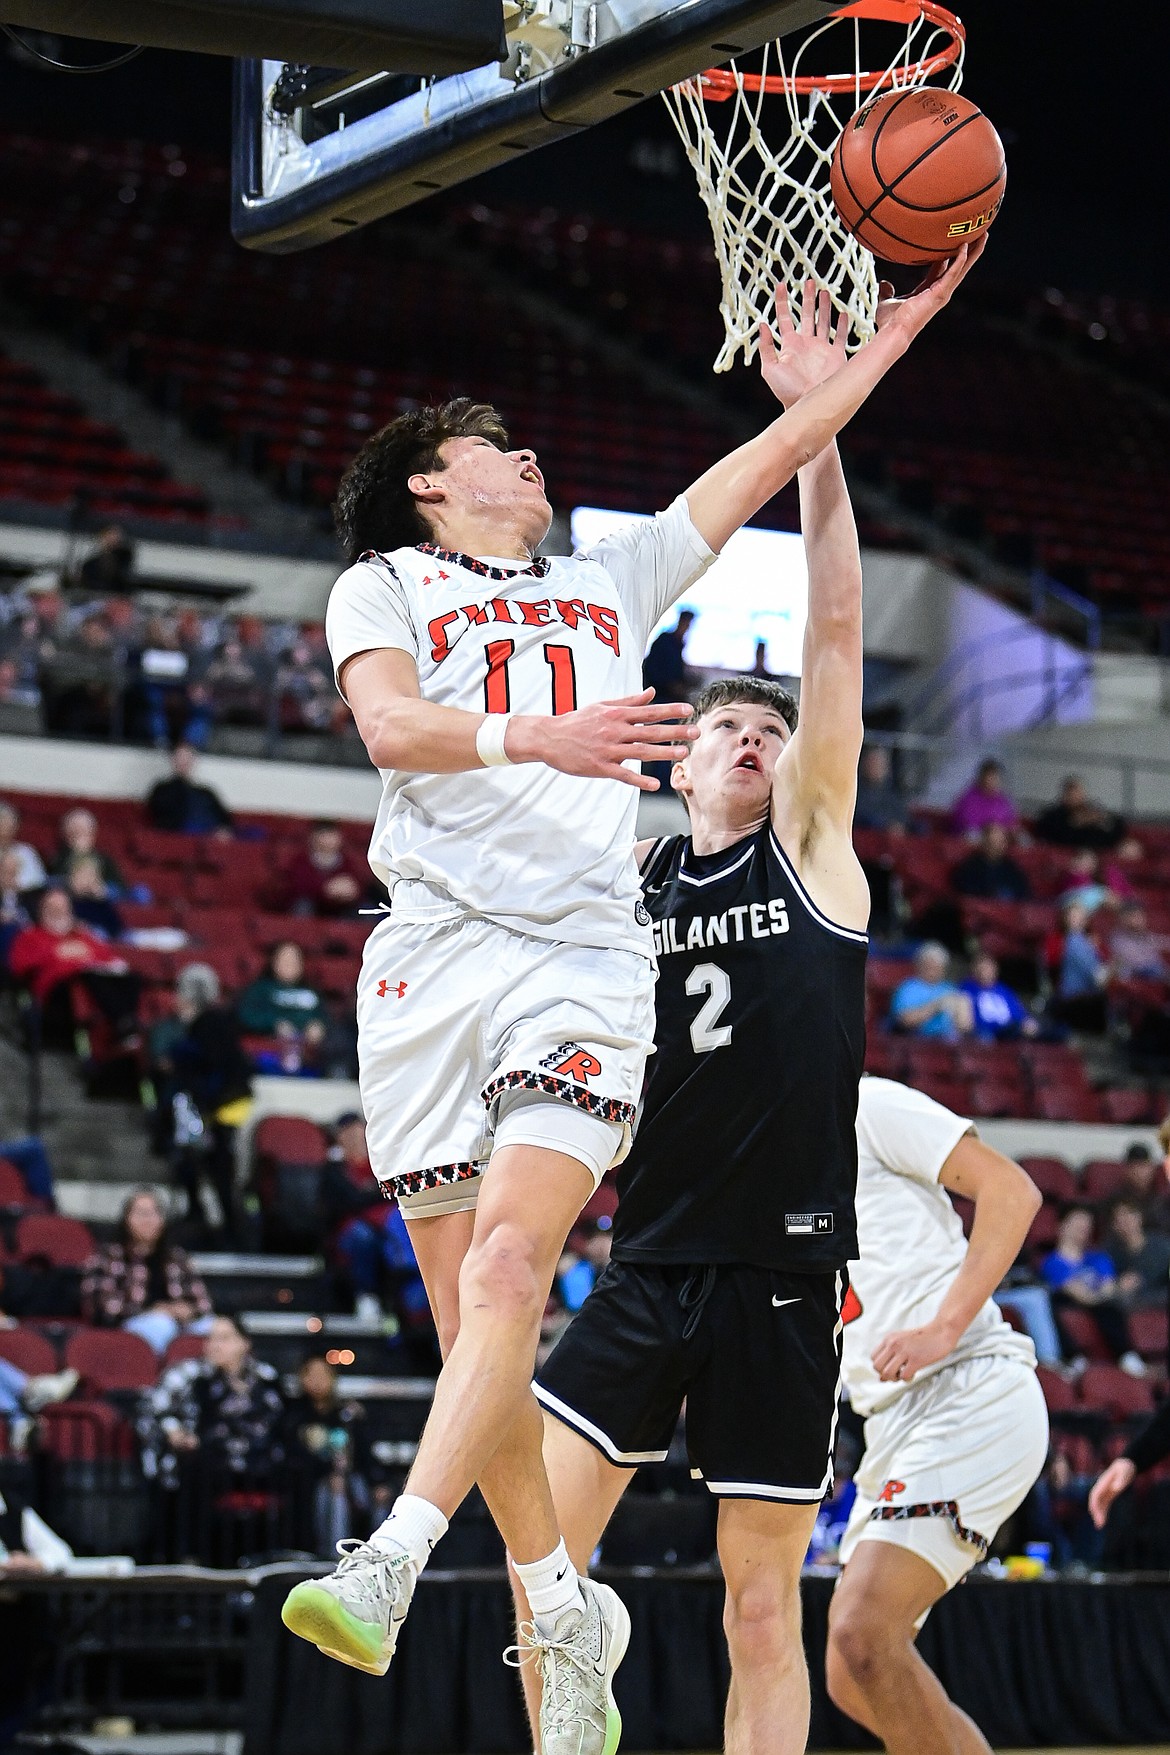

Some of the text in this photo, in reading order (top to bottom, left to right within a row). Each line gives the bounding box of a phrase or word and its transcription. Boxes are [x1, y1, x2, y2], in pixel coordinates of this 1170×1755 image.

[428, 598, 621, 663] CHIEFS
[484, 639, 578, 716] 11
[653, 898, 790, 957] GILANTES
[685, 962, 733, 1054] 2
[551, 1049, 602, 1085] R
[818, 1218, 828, 1229] M
